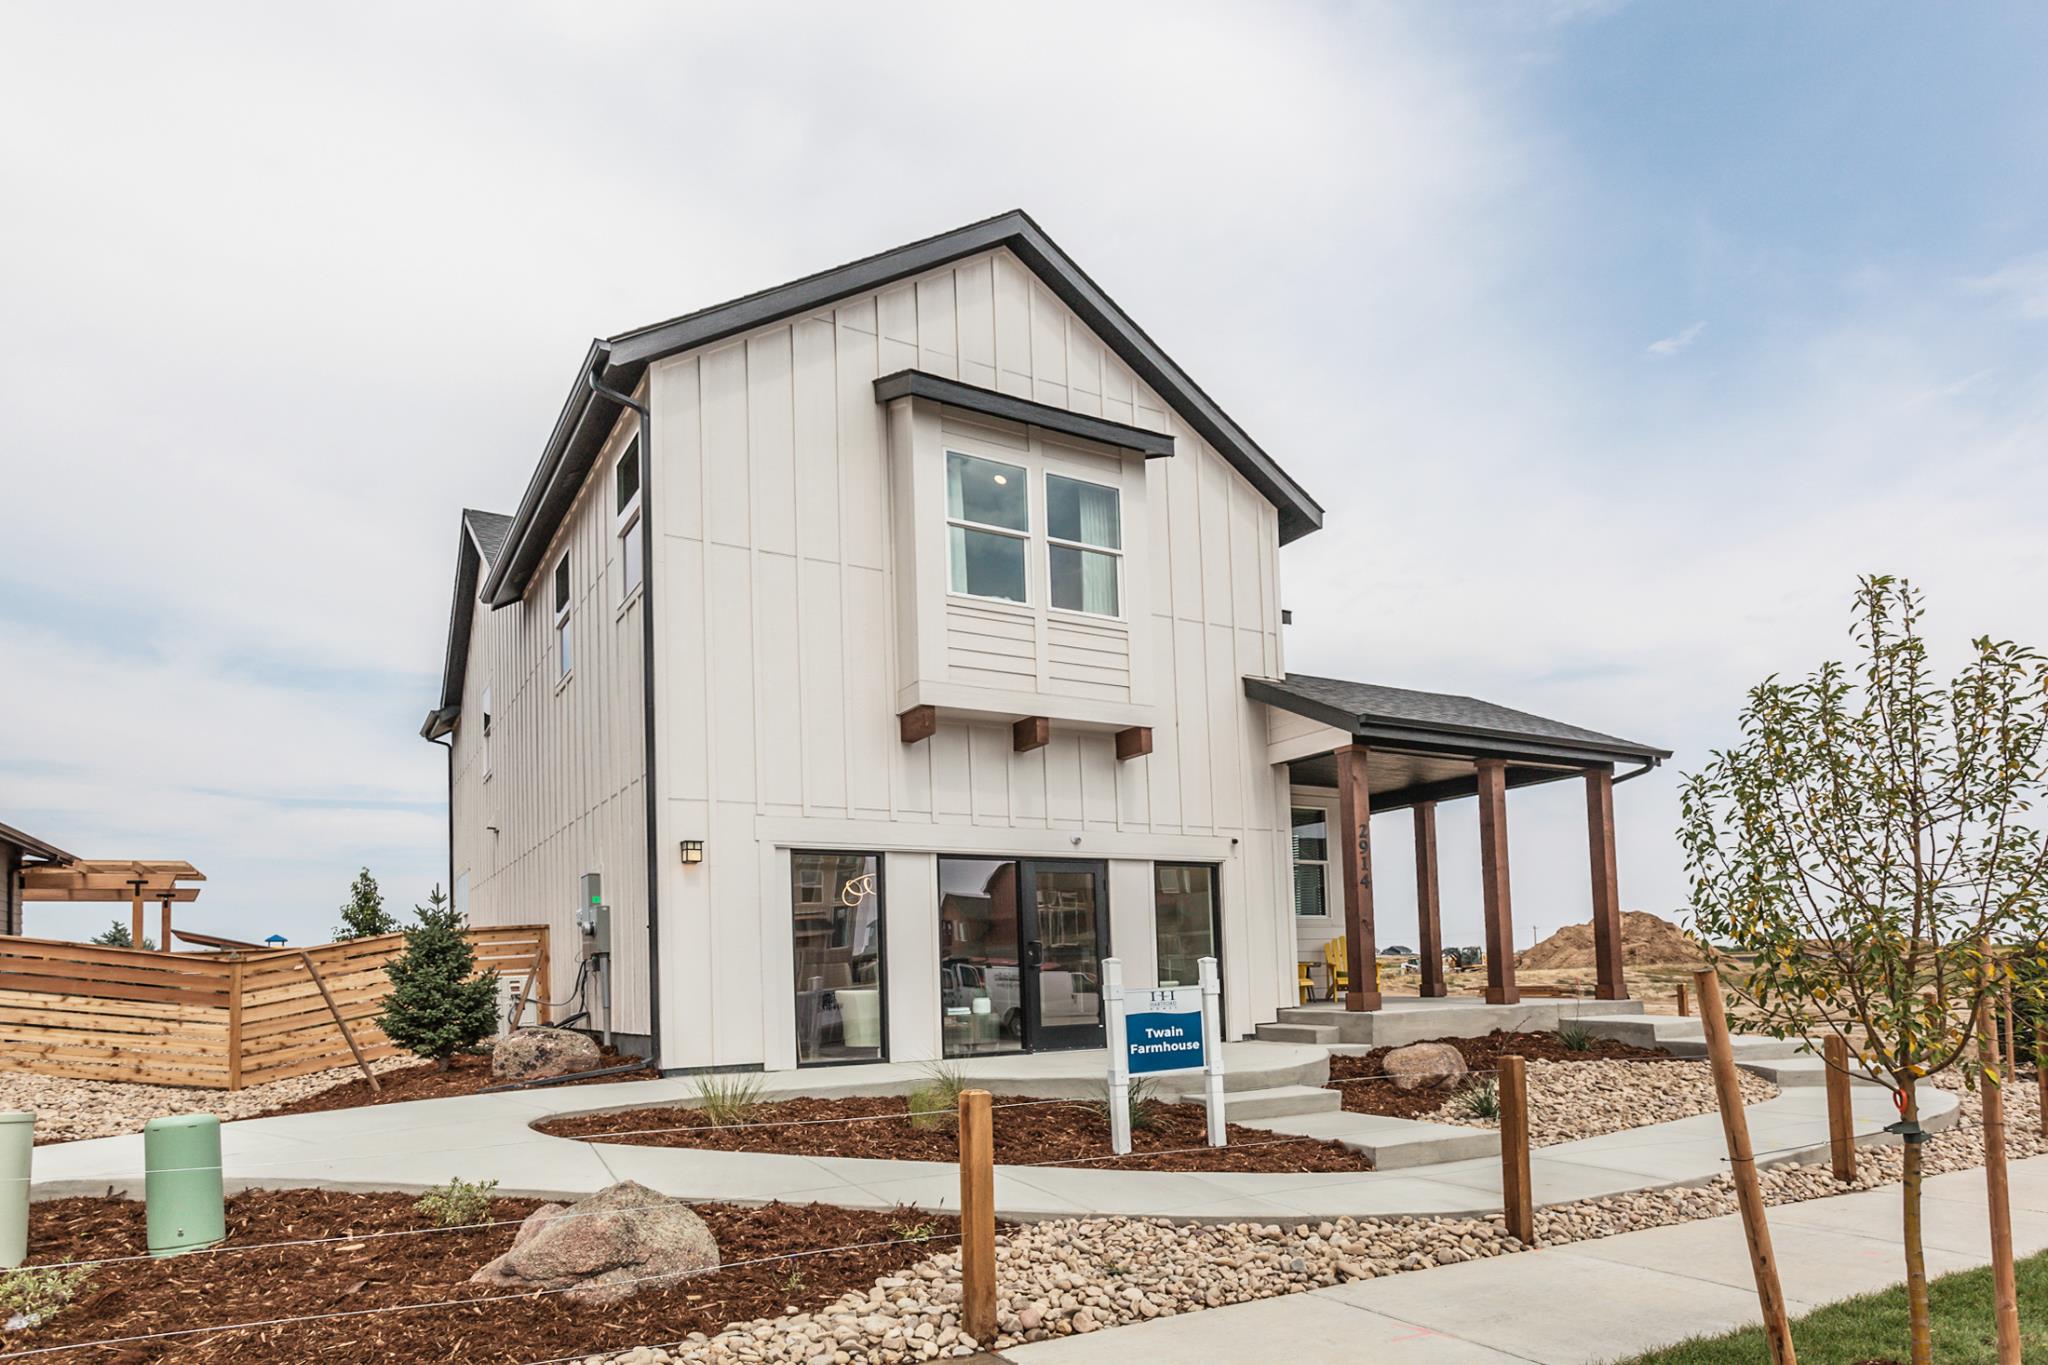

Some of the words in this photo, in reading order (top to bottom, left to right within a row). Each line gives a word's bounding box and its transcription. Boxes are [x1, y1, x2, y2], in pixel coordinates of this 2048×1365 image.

[1359, 824, 1370, 889] 2914
[1145, 1026, 1184, 1039] Twain
[1130, 1041, 1200, 1055] Farmhouse
